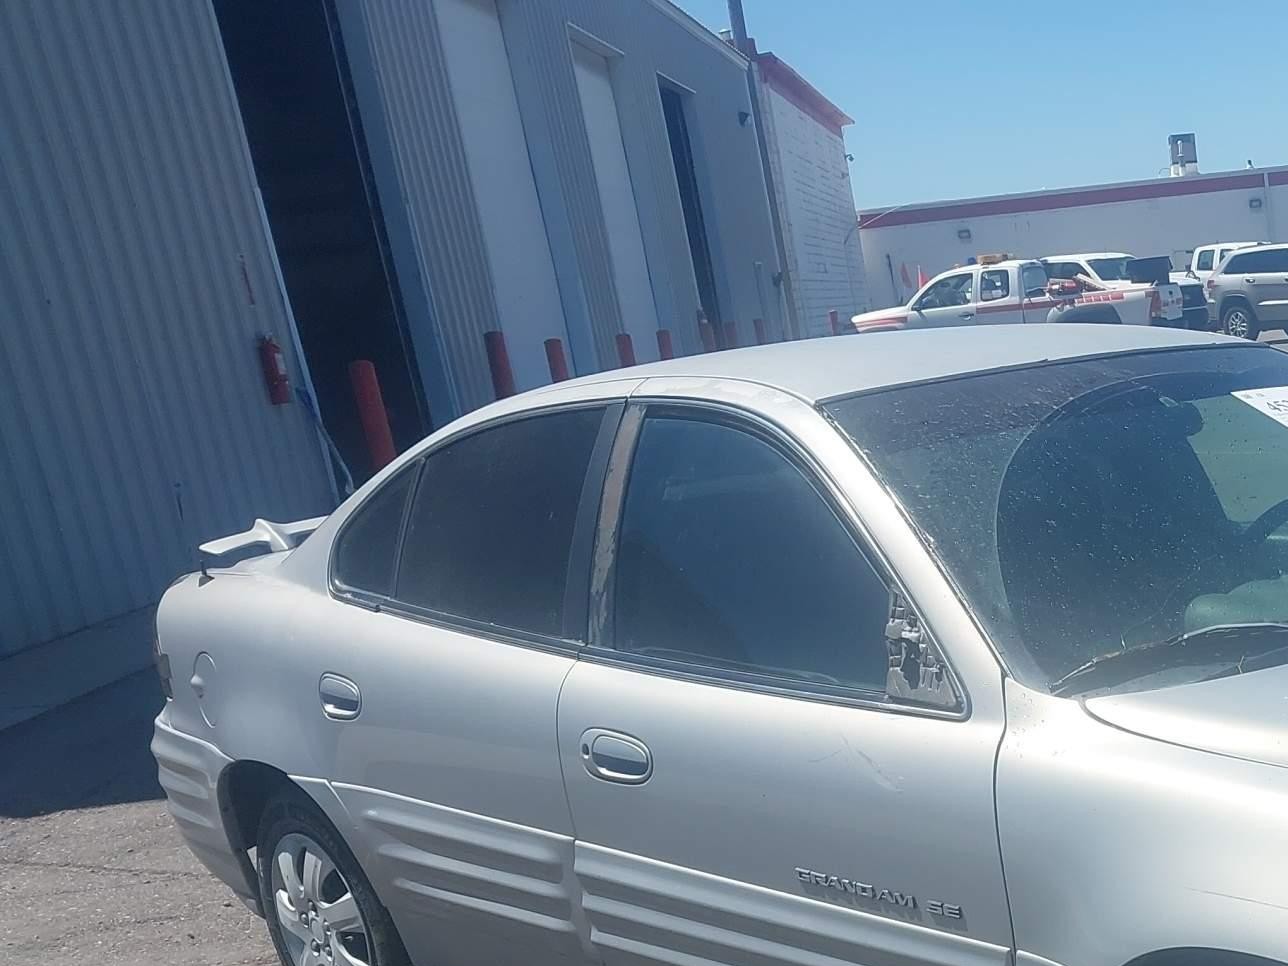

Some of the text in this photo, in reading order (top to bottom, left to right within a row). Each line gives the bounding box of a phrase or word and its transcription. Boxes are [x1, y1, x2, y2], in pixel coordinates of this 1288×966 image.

[794, 866, 963, 919] GRAND AM SE
